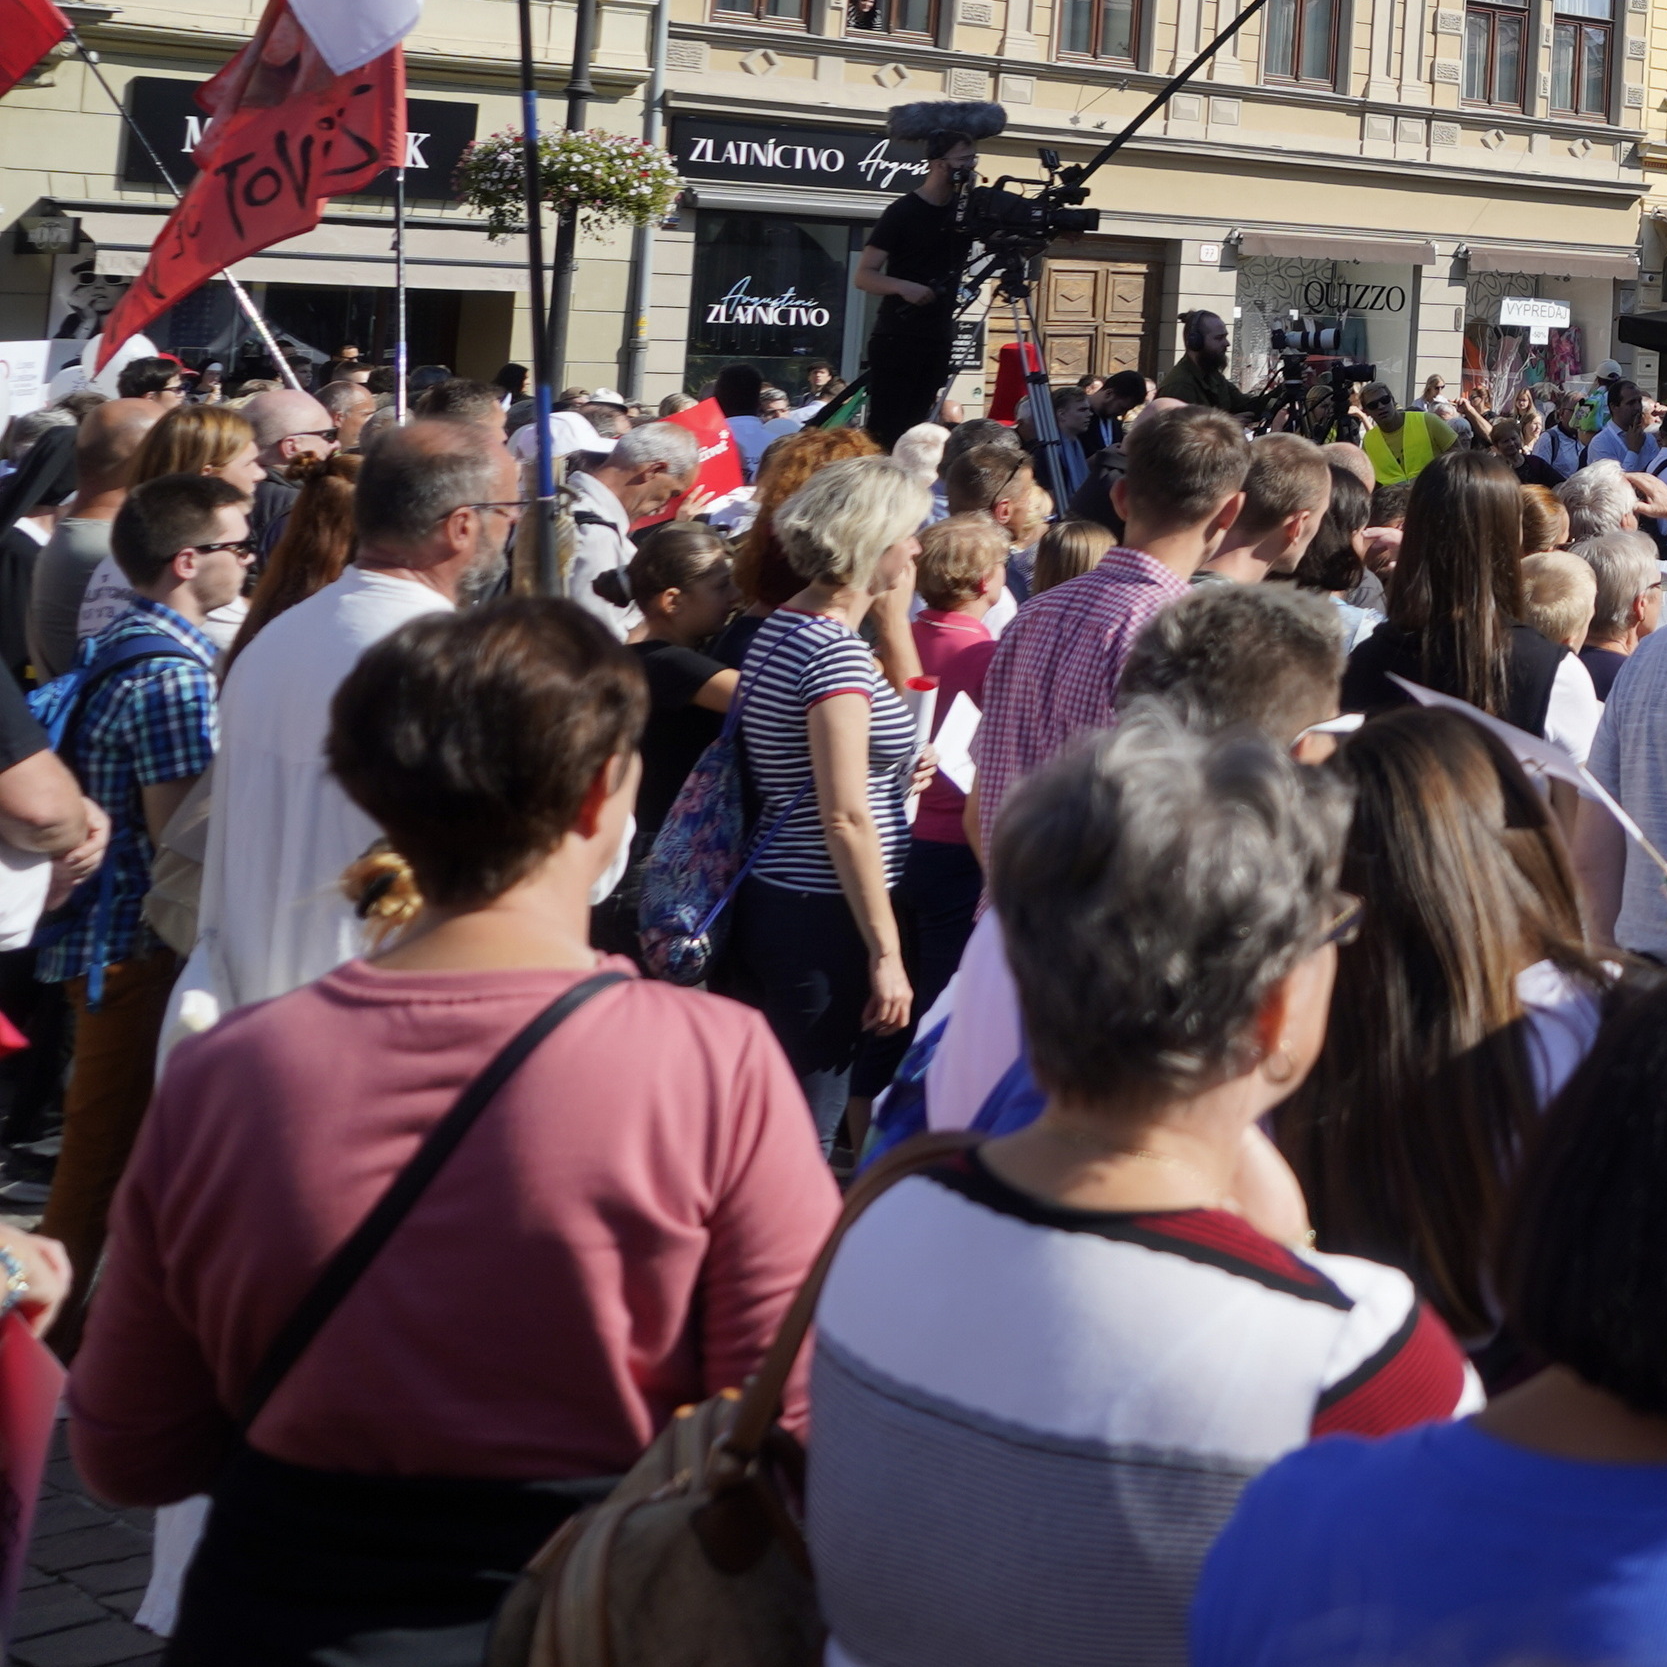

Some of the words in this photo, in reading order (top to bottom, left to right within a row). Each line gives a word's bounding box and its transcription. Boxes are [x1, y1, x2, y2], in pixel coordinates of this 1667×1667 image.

[689, 137, 845, 172] ZLATNÍCTVO
[857, 138, 931, 189] August
[1304, 280, 1406, 312] QUIZZO
